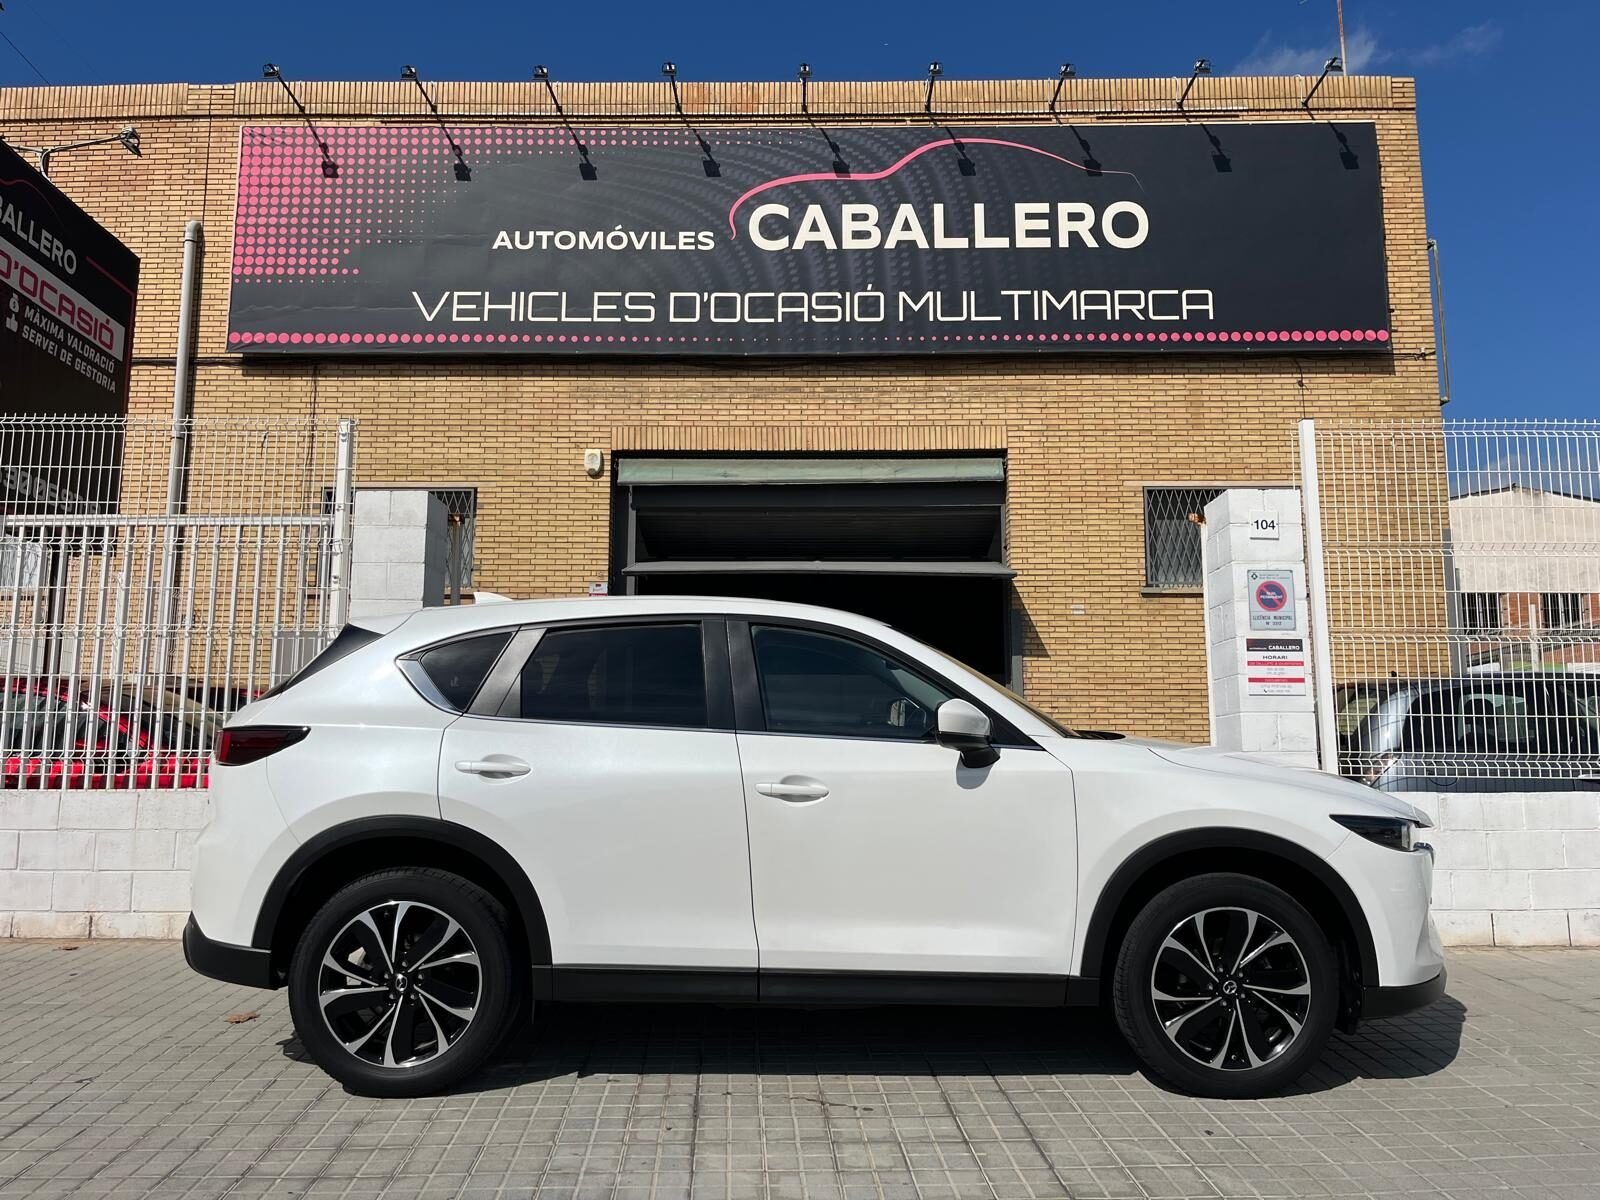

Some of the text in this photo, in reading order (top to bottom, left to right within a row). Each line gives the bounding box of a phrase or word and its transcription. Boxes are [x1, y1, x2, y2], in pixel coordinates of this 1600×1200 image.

[492, 201, 1149, 251] AUTOMÓVILES CABALLERO
[412, 284, 1214, 323] VEHICLES D'OCASIÓ MULTIMARCA
[22, 325, 116, 393] SERVEI DE GESTORIA
[24, 305, 115, 374] MÀXIMA VALORACIÓ
[1253, 519, 1276, 530] 104
